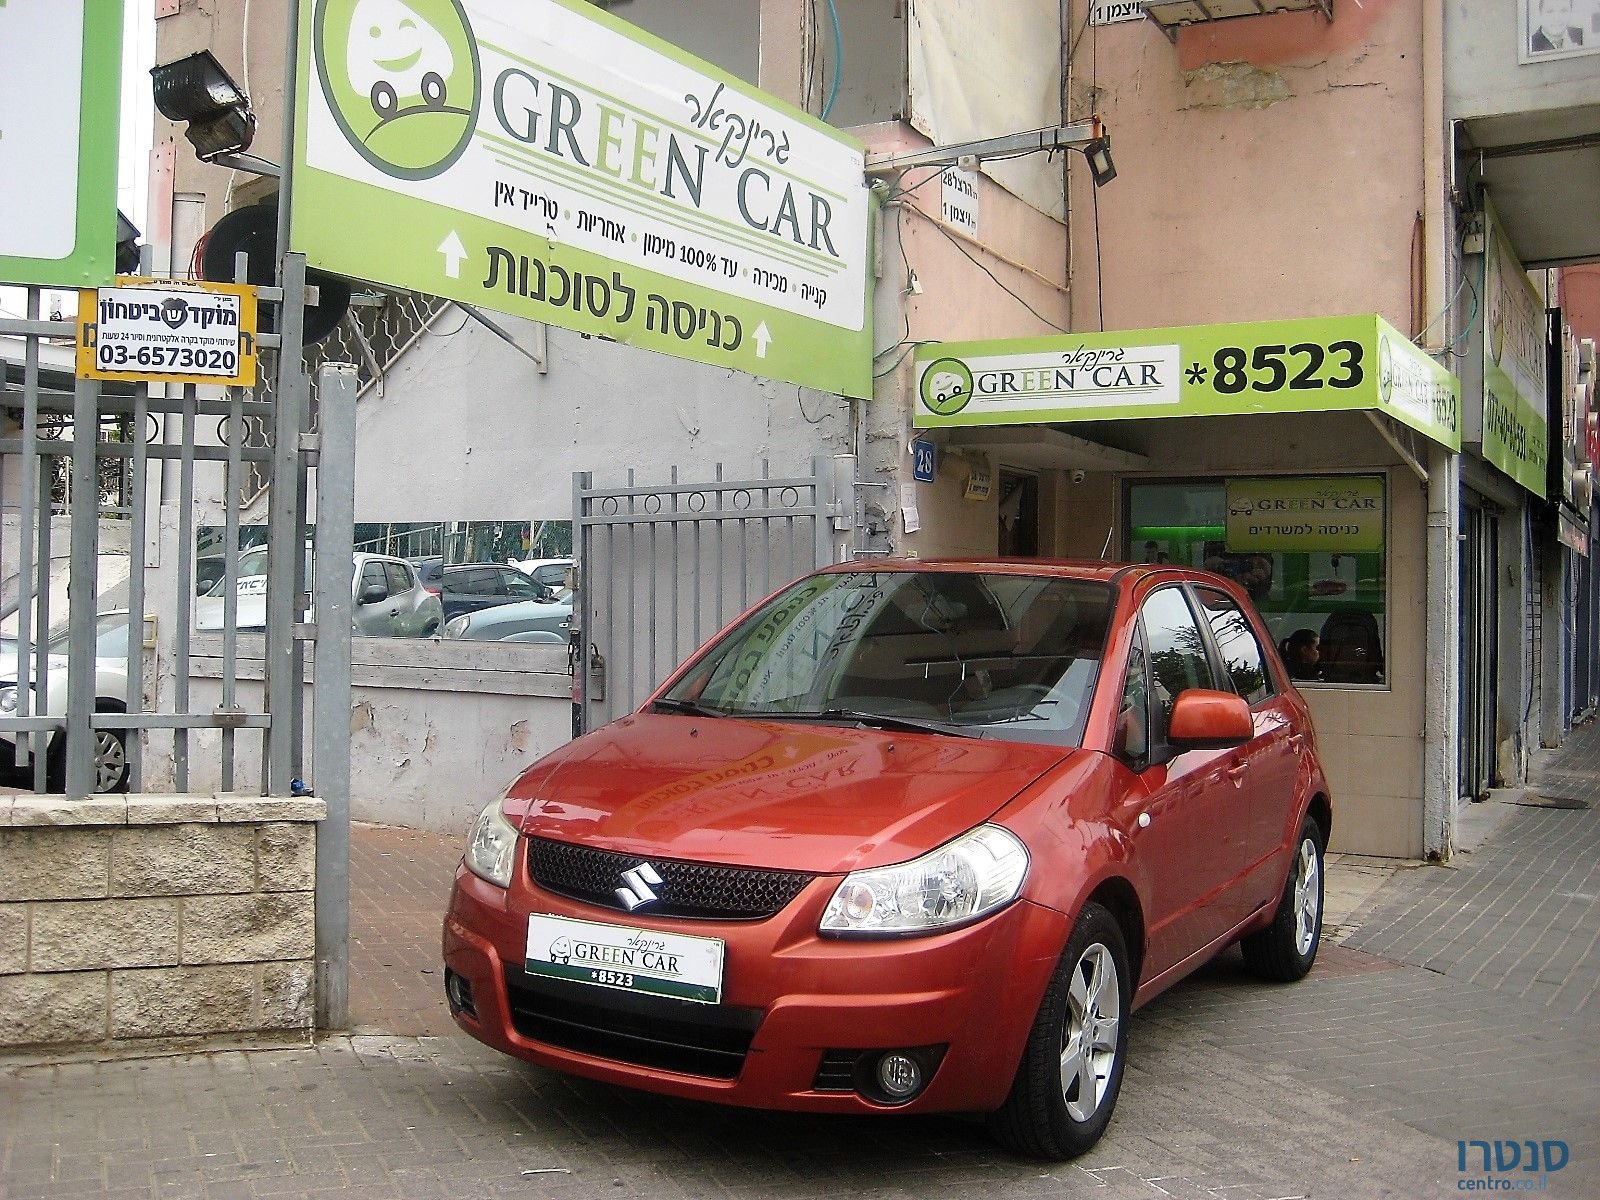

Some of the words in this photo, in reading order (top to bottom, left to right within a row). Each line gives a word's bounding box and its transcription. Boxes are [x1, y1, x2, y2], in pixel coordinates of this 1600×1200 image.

[684, 82, 790, 169] גרינקאר
[492, 67, 709, 208] GREEN
[737, 167, 839, 257] CAR
[494, 178, 515, 208] אין
[519, 188, 559, 220] טרייד
[576, 208, 626, 244] אחריות
[643, 231, 675, 259] מימון
[680, 245, 717, 272] 100%
[720, 256, 738, 279] עד
[753, 266, 788, 294] מכירה
[483, 246, 636, 323] לסוכנות
[800, 282, 827, 309] קנייה
[646, 293, 742, 351] כניסה
[120, 332, 130, 341] 24
[100, 344, 236, 370] 03-6573020
[1061, 344, 1125, 372] גרינקאר
[977, 368, 1077, 394] GREEN
[1092, 364, 1162, 388] CAR
[917, 448, 932, 474] 28
[1335, 498, 1376, 509] CAR
[1248, 523, 1313, 535] למשרדים
[1318, 524, 1360, 535] כניסה
[575, 943, 635, 965] GREEN
[643, 952, 680, 973] CAR
